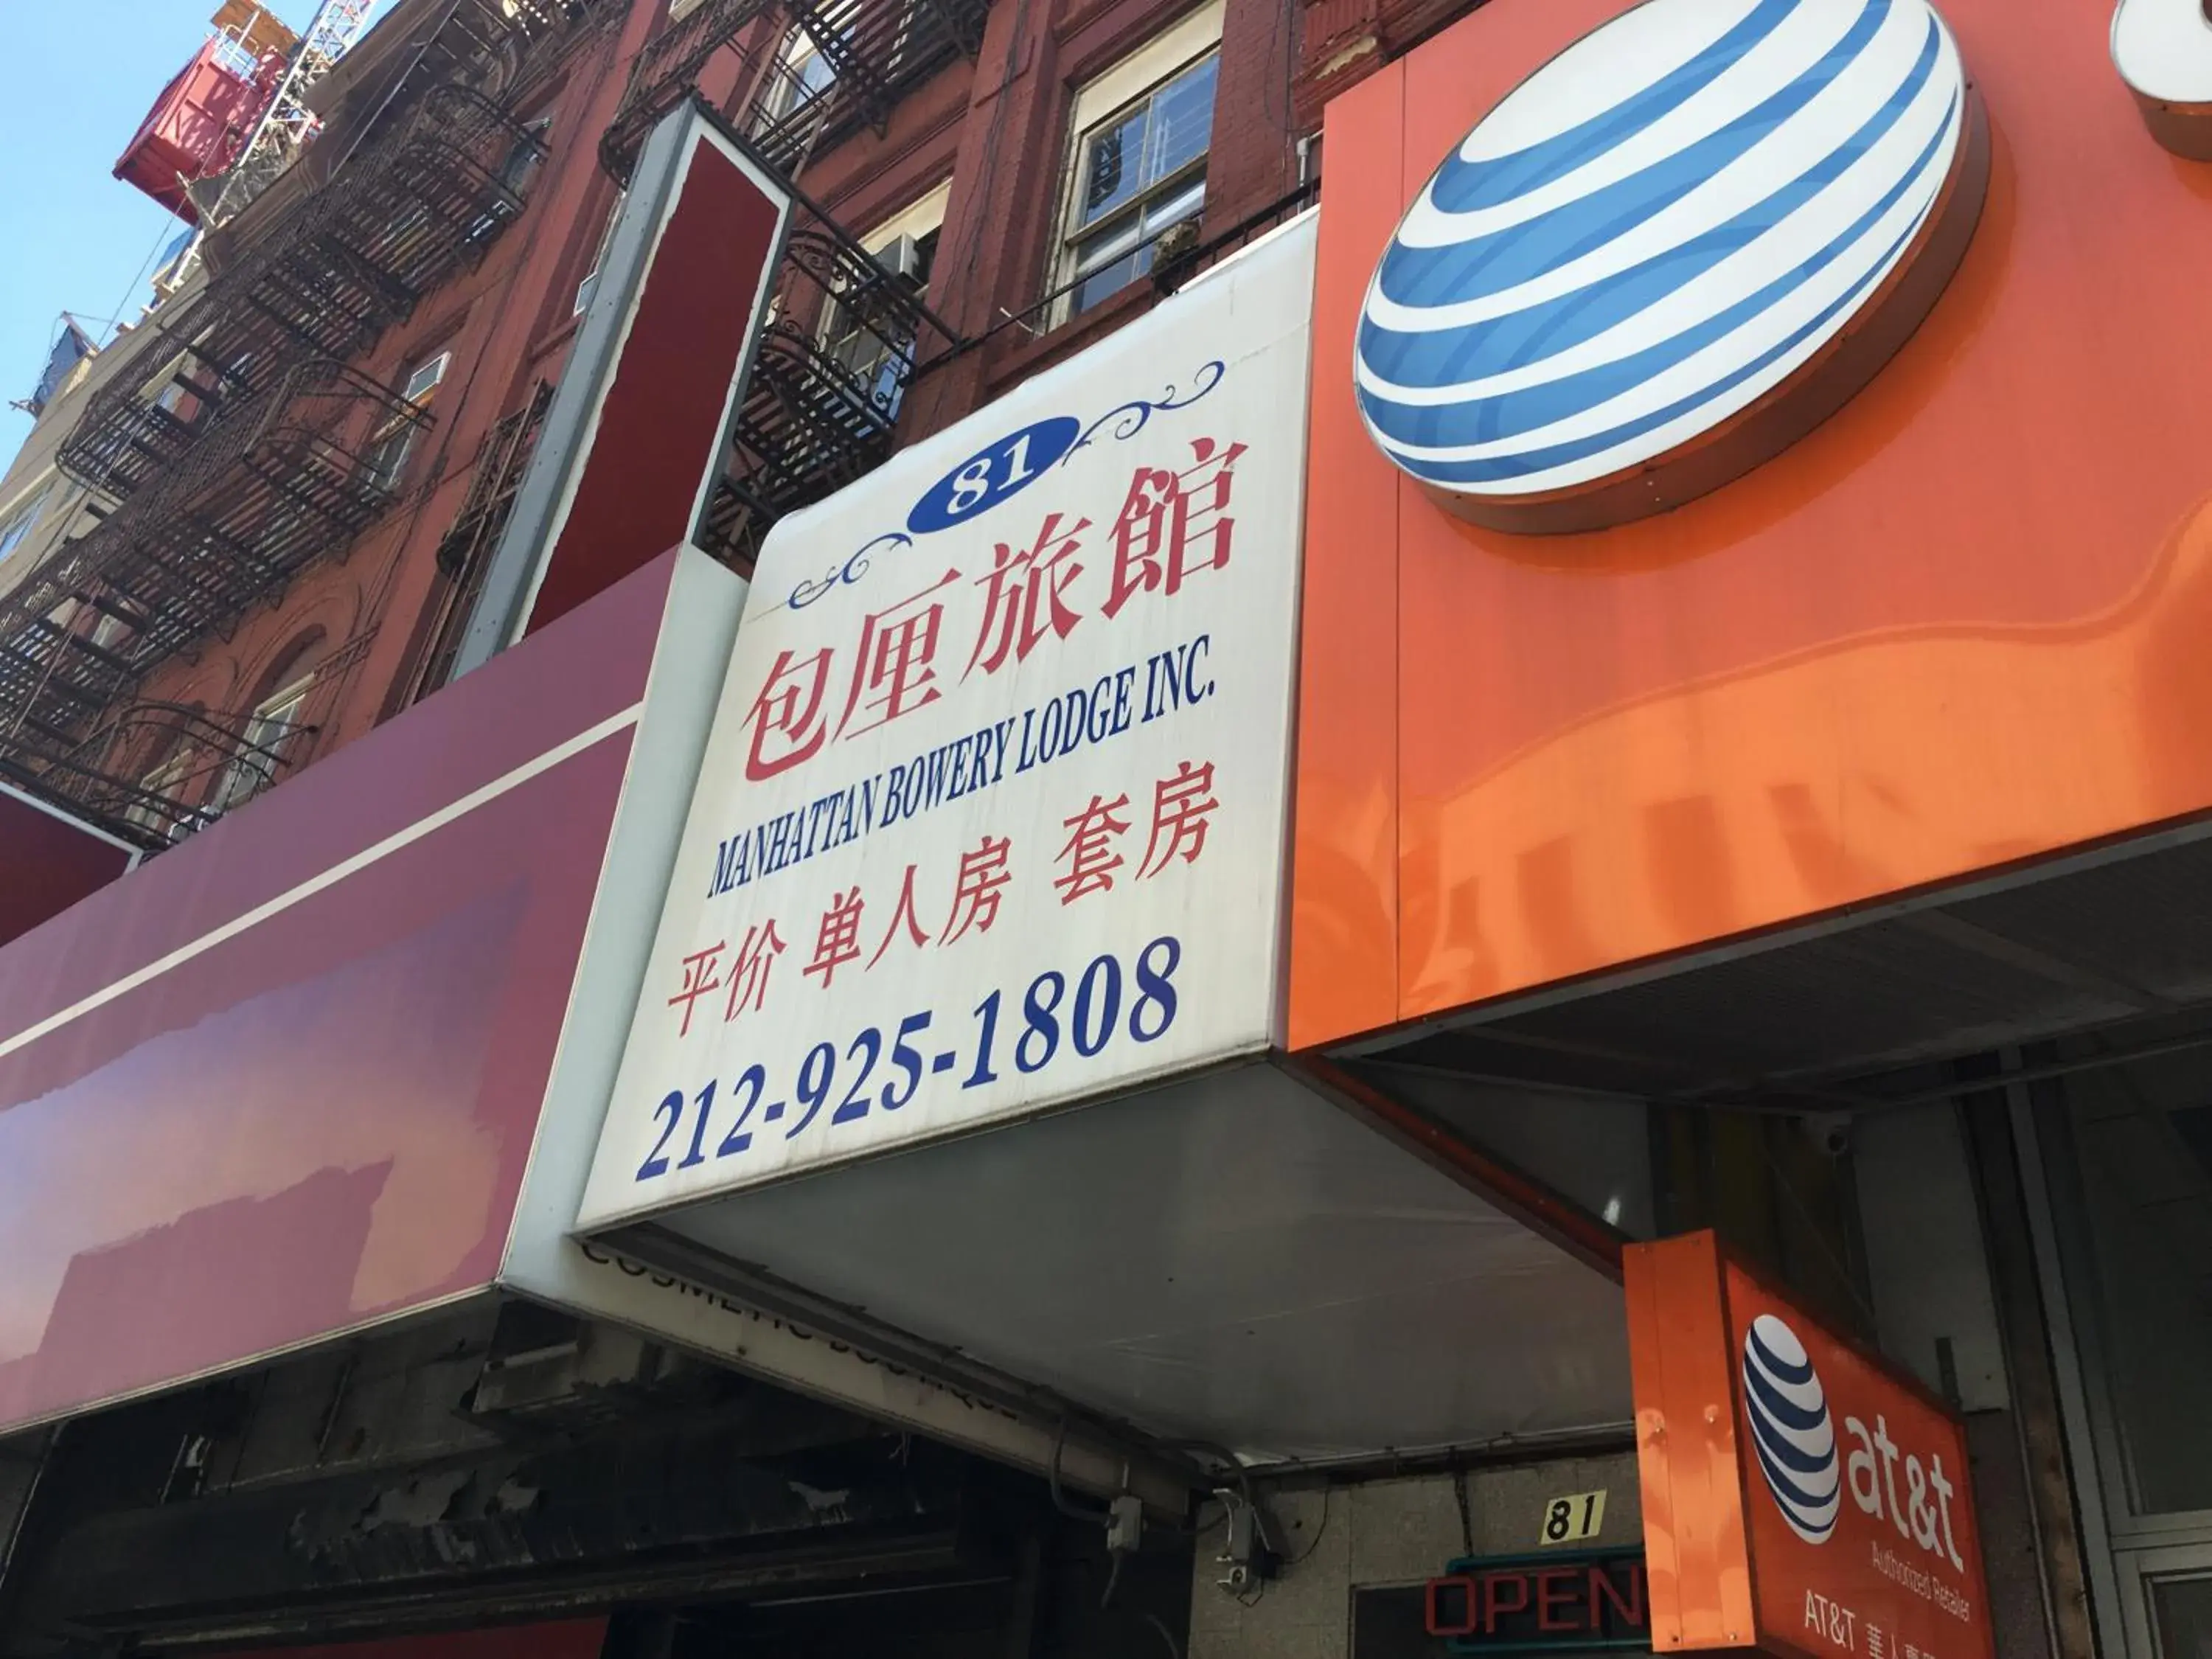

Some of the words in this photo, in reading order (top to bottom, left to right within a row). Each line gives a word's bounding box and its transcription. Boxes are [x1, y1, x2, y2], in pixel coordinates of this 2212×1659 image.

[947, 434, 1034, 514] 81
[740, 436, 1249, 782] 包厘旅館
[706, 774, 882, 899] MANHATTAN
[880, 718, 1017, 827] BOWERY
[1015, 666, 1135, 775] LODGE
[1140, 636, 1217, 723] INC.
[667, 917, 787, 1038] 平价
[802, 835, 1013, 990] 单人房
[1053, 760, 1220, 908] 套房
[635, 935, 1182, 1181] 212-925-1808
[1546, 1494, 1595, 1542] 81
[1845, 1413, 1964, 1573] at&t
[1425, 1564, 1644, 1636] OPEN
[1804, 1588, 1857, 1652] AT&T
[1872, 1540, 1932, 1600] Authorized
[1932, 1575, 1970, 1622] Retailer
